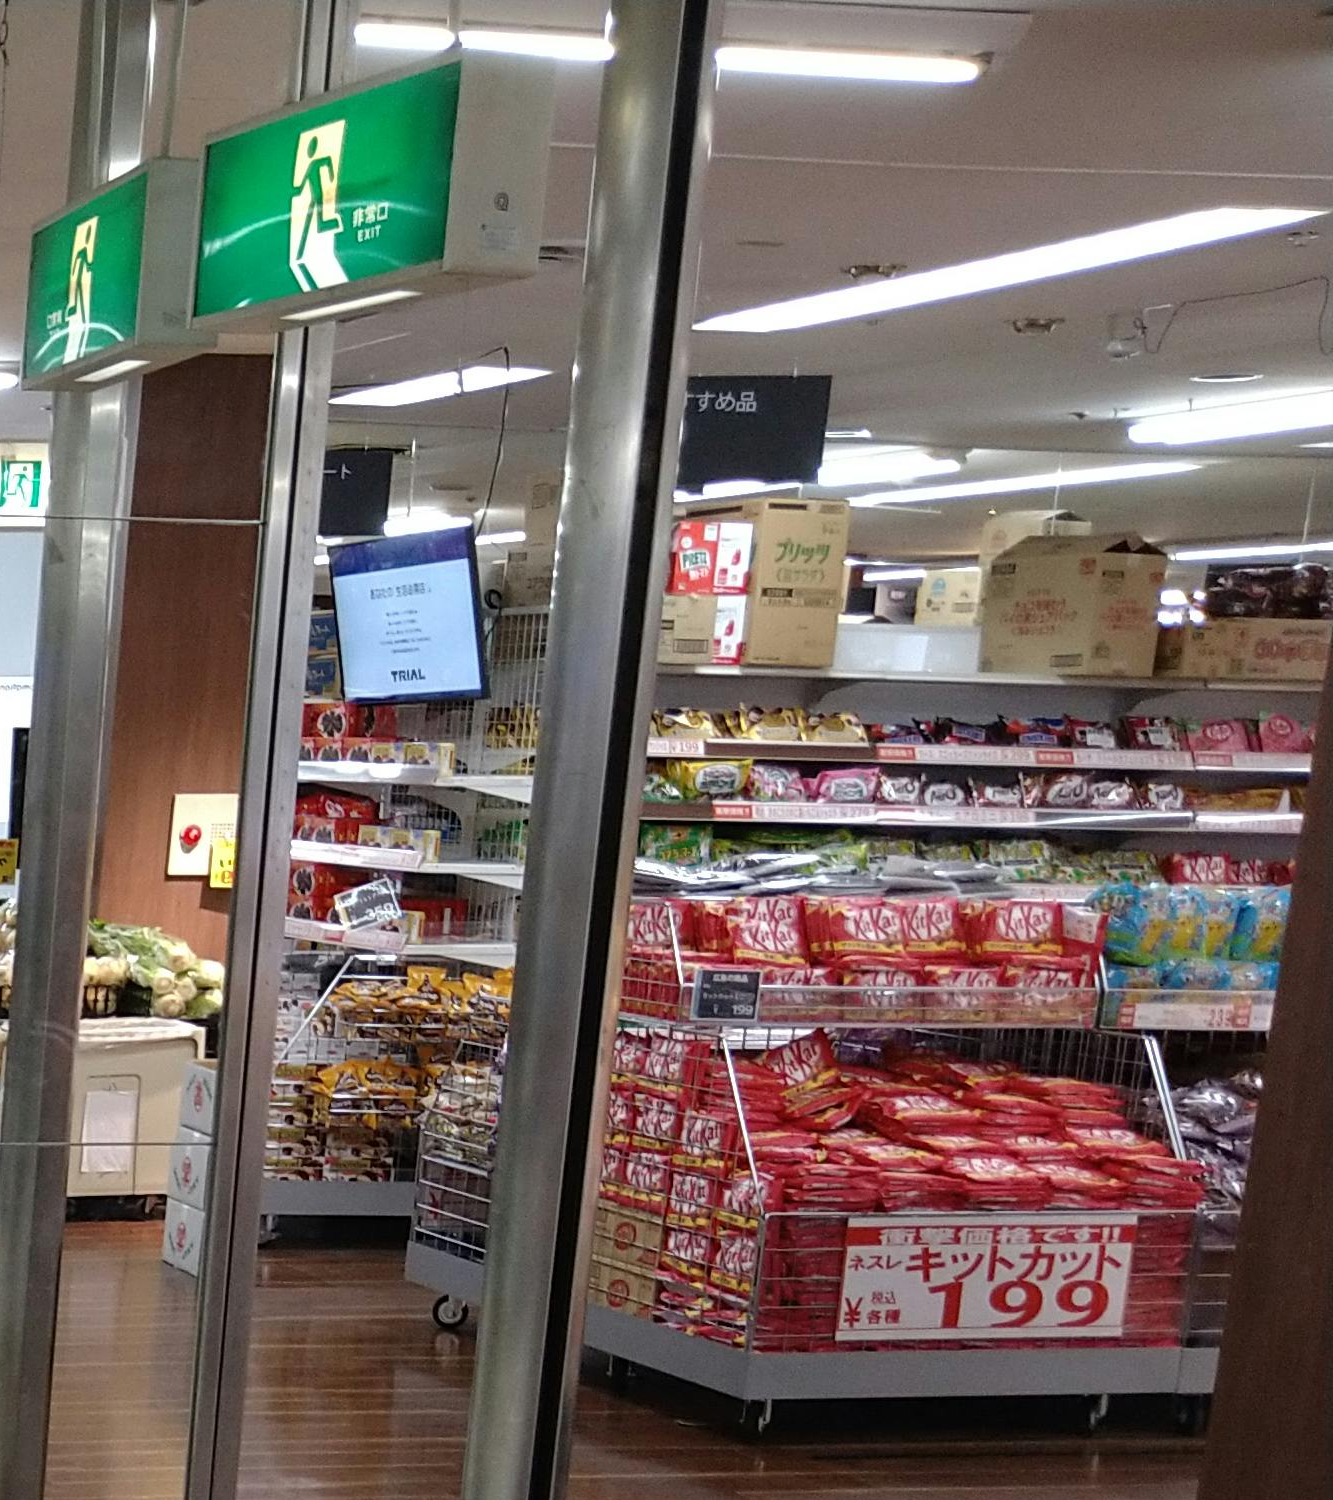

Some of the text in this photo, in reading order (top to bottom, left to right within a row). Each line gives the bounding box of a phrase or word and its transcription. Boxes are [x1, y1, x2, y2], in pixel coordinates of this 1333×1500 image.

[357, 225, 381, 243] EXIT
[391, 668, 426, 683] TRIAL
[853, 907, 899, 940] KitKat
[1003, 906, 1050, 940] KitKat
[848, 1245, 1123, 1282] ネスレ キットカット
[928, 1280, 1110, 1329] 199
